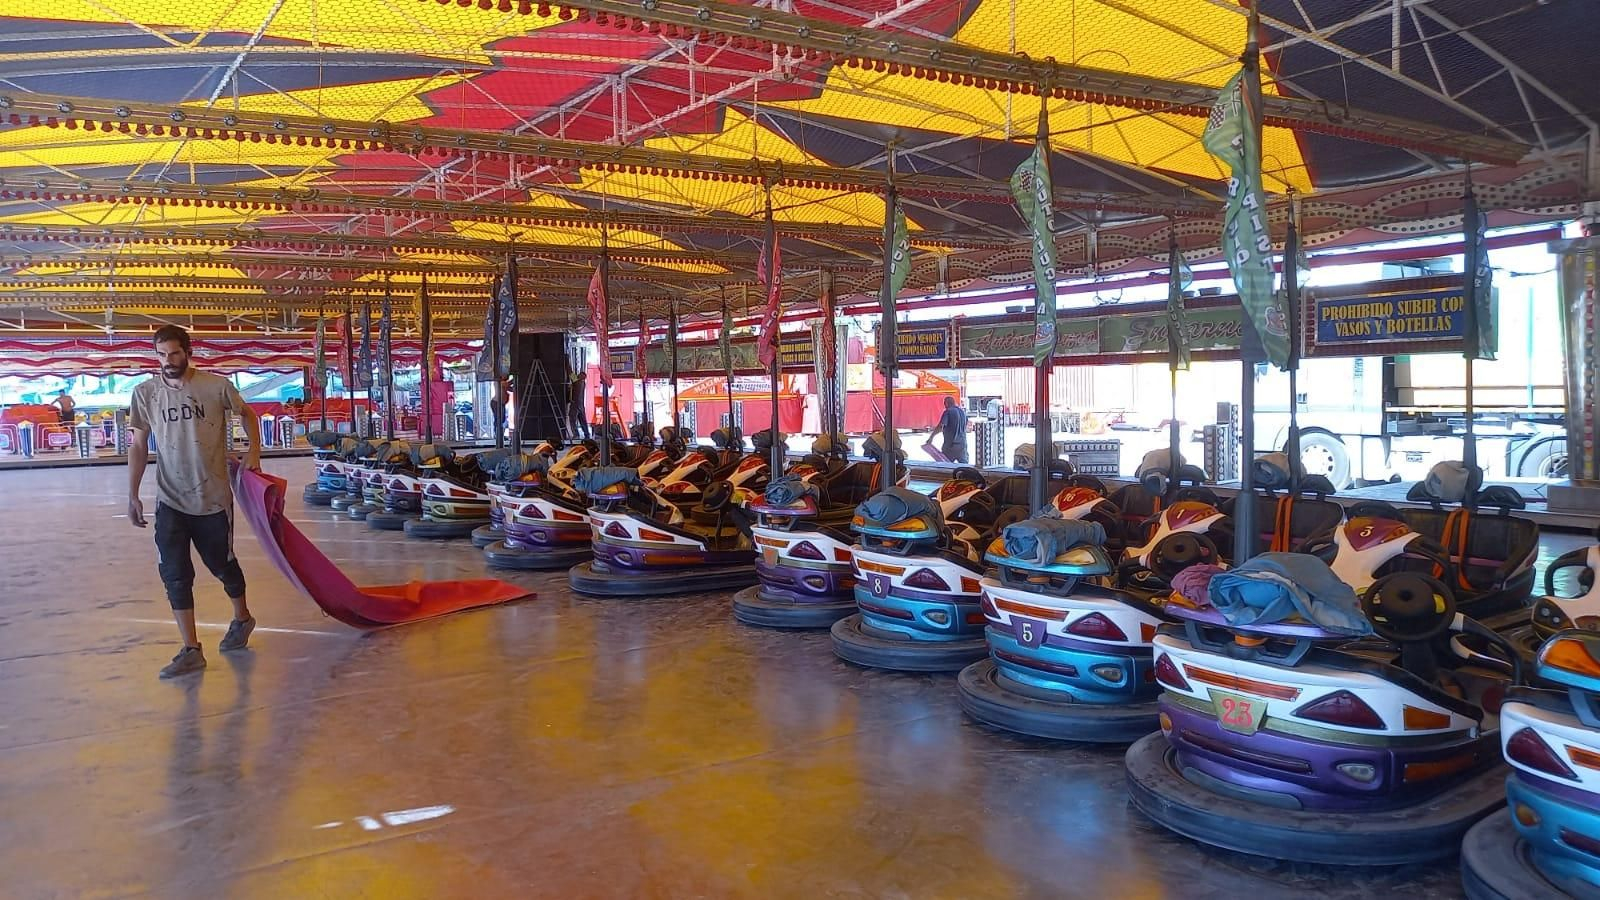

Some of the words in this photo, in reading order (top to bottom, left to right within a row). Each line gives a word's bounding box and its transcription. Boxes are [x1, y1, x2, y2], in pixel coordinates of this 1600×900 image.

[1321, 302, 1394, 321] PROHIBIDO
[1397, 298, 1437, 316] SUBIR
[1335, 321, 1371, 337] VASOS
[1373, 320, 1384, 334] Y
[1386, 315, 1452, 334] BOTELLAS
[162, 403, 206, 423] ICON
[874, 577, 882, 594] 8
[1022, 622, 1033, 643] 5
[1221, 697, 1253, 729] 23
